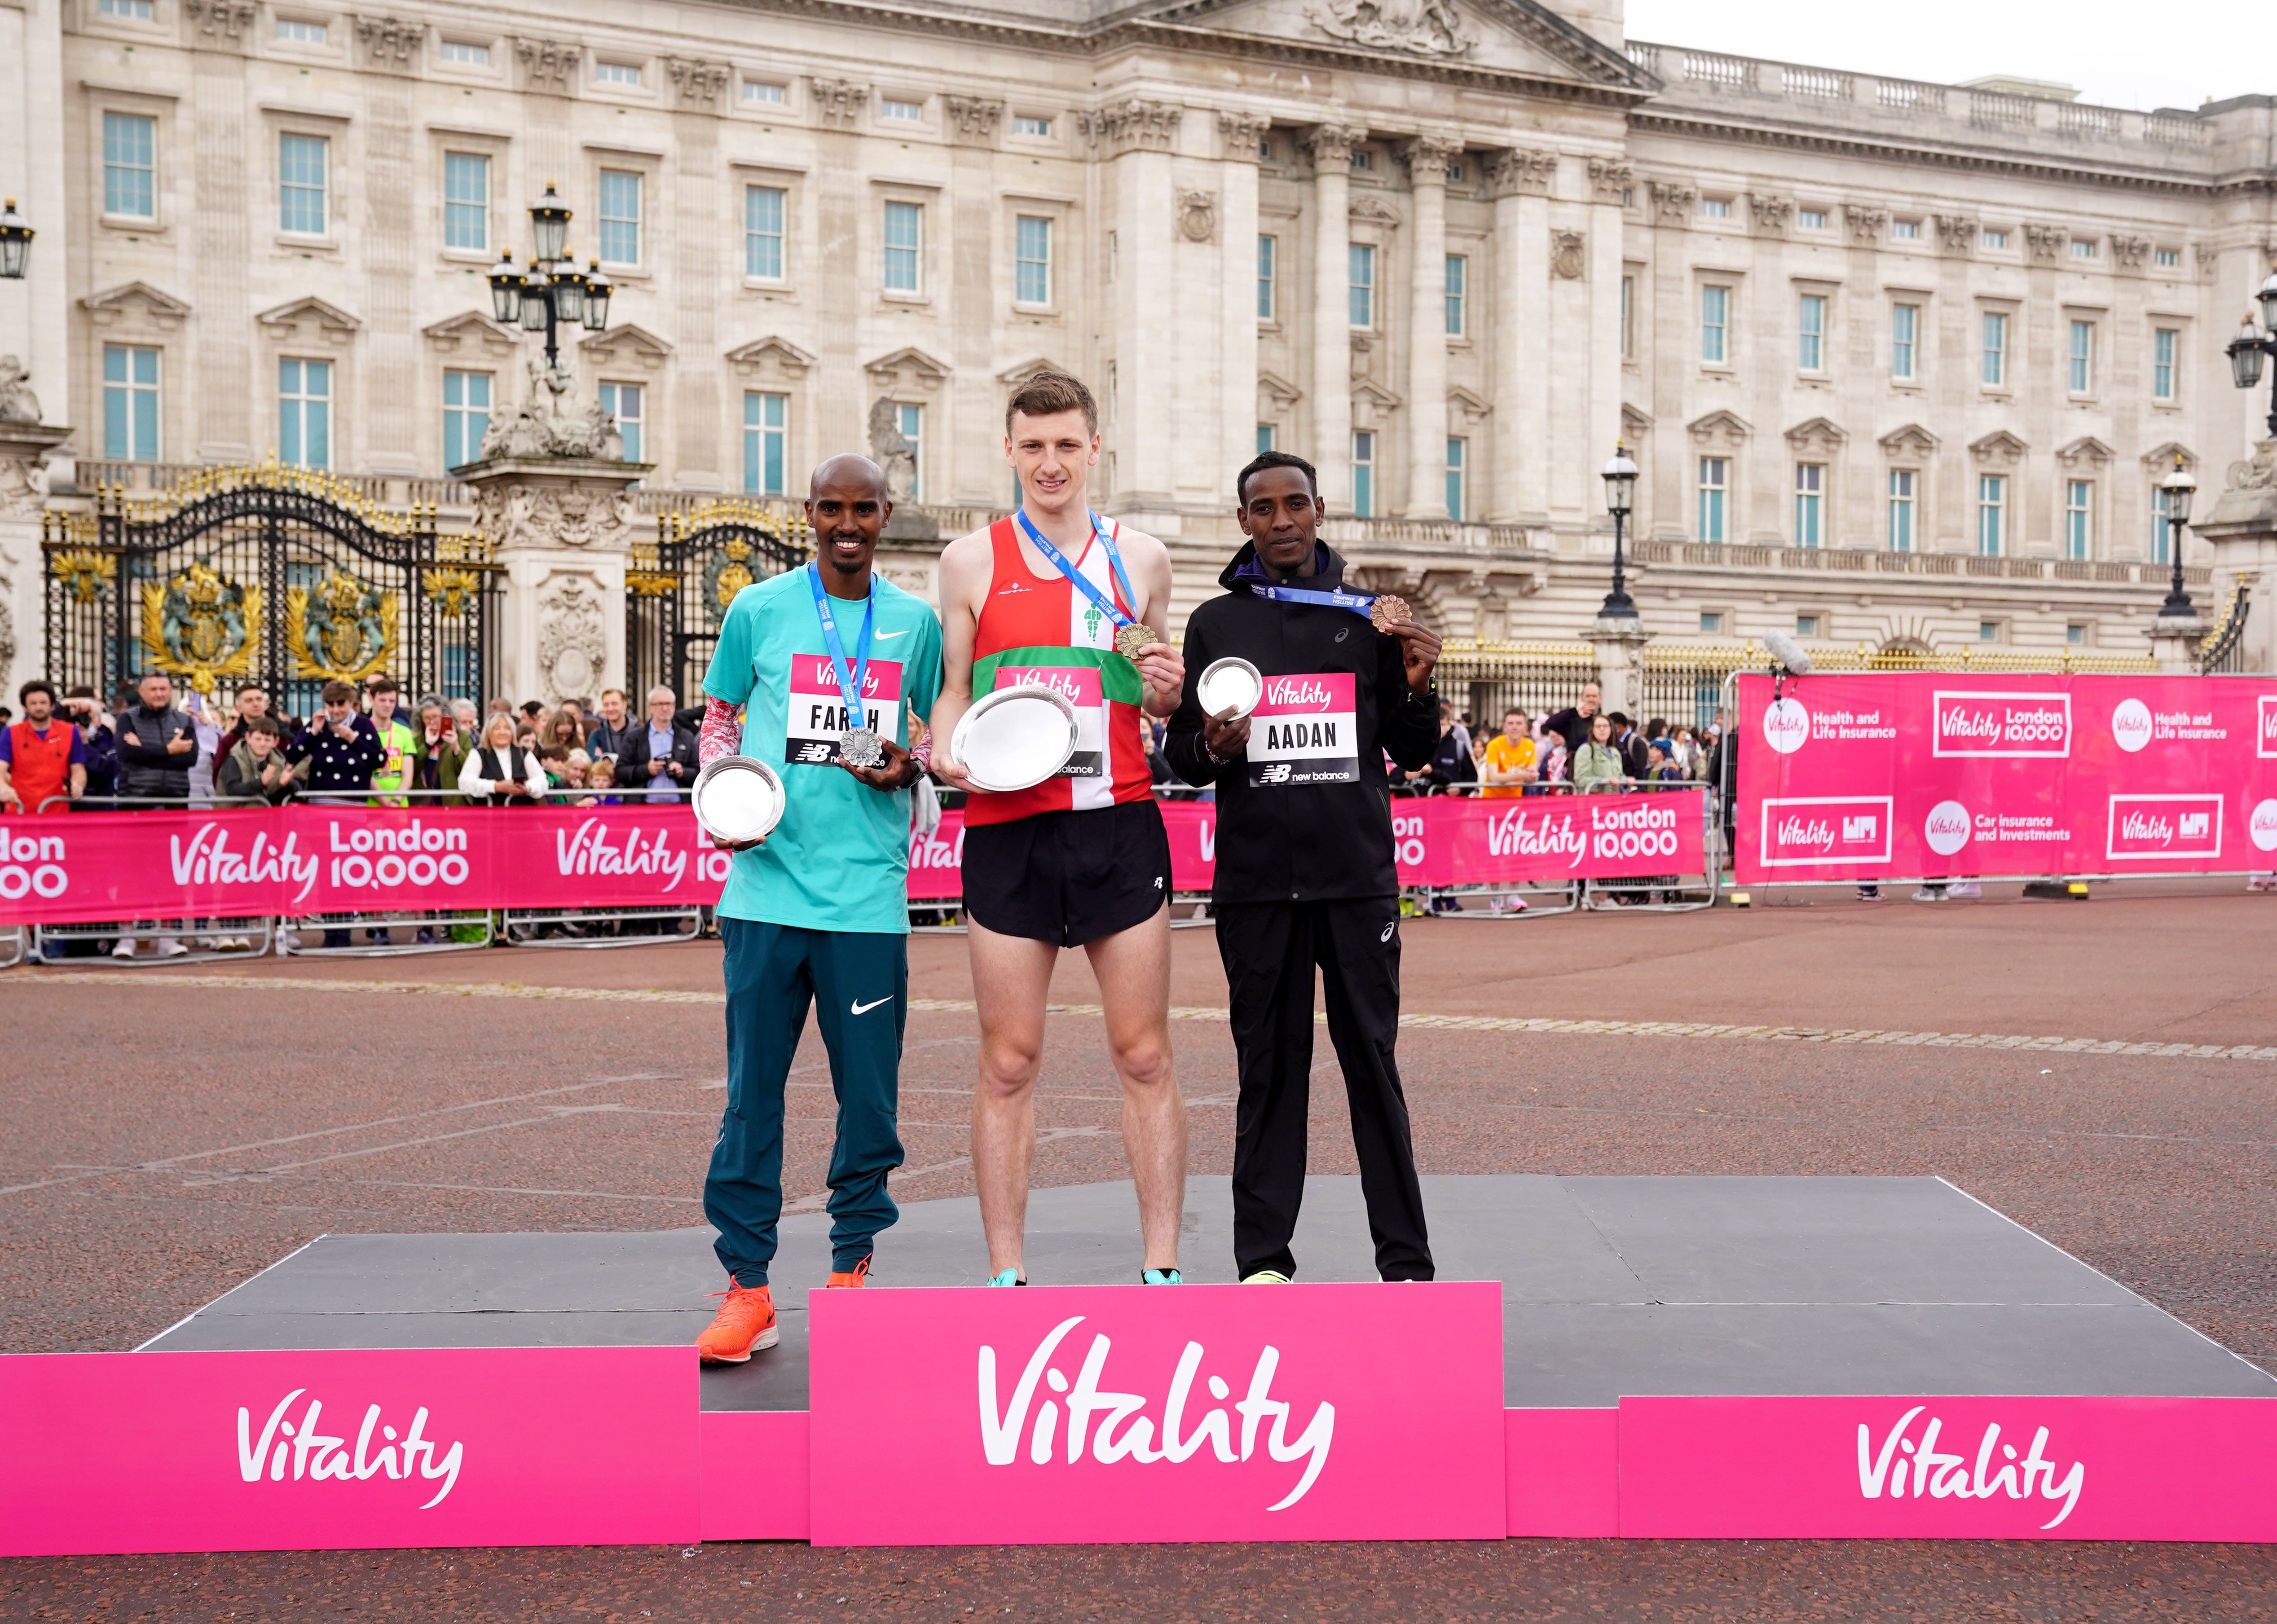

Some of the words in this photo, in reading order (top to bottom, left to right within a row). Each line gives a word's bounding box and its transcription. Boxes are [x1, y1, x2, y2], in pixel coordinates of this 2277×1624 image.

[1035, 537, 1051, 555] BRITISH
[1105, 537, 1117, 555] BRITISH
[818, 600, 827, 620] BRITISH
[822, 599, 831, 619] ATHLETICS
[1097, 600, 1113, 615] BRITISH
[843, 684, 852, 704] BRITISH
[1267, 677, 1332, 712] Vitality
[810, 704, 879, 734] FARH
[1769, 714, 1804, 738] Vitality
[1812, 710, 1854, 726] Health
[1856, 710, 1880, 726] and
[1942, 705, 2002, 746] Vitality
[2006, 707, 2063, 725] London
[2117, 713, 2148, 737] Vitality
[2154, 712, 2190, 726] Health
[2191, 712, 2212, 726] and
[1267, 722, 1336, 750] AADAN
[1812, 726, 1837, 739] Life
[1839, 725, 1897, 739] insurance
[2004, 724, 2063, 743] 10,000
[2154, 726, 2176, 739] Life
[2177, 726, 2227, 739] insurance
[1312, 771, 1350, 781] balance
[1592, 803, 1676, 831] London
[1930, 816, 1965, 840] Vitality
[1975, 814, 1997, 828] Car
[1999, 814, 2053, 827] insurance
[2122, 810, 2173, 848] Vitality
[330, 819, 467, 852] London
[1488, 806, 1587, 868] Vitality
[1593, 830, 1678, 860] 10,000
[1778, 815, 1835, 853] Vitality
[1974, 828, 1997, 841] and
[2000, 828, 2070, 841] Investments
[171, 822, 319, 904] Vitality
[557, 817, 687, 893] Vitality
[331, 852, 470, 890] 10,000
[978, 1316, 1335, 1511] Vitality
[238, 1388, 463, 1509] Vitality
[1857, 1406, 2084, 1530] Vitality
